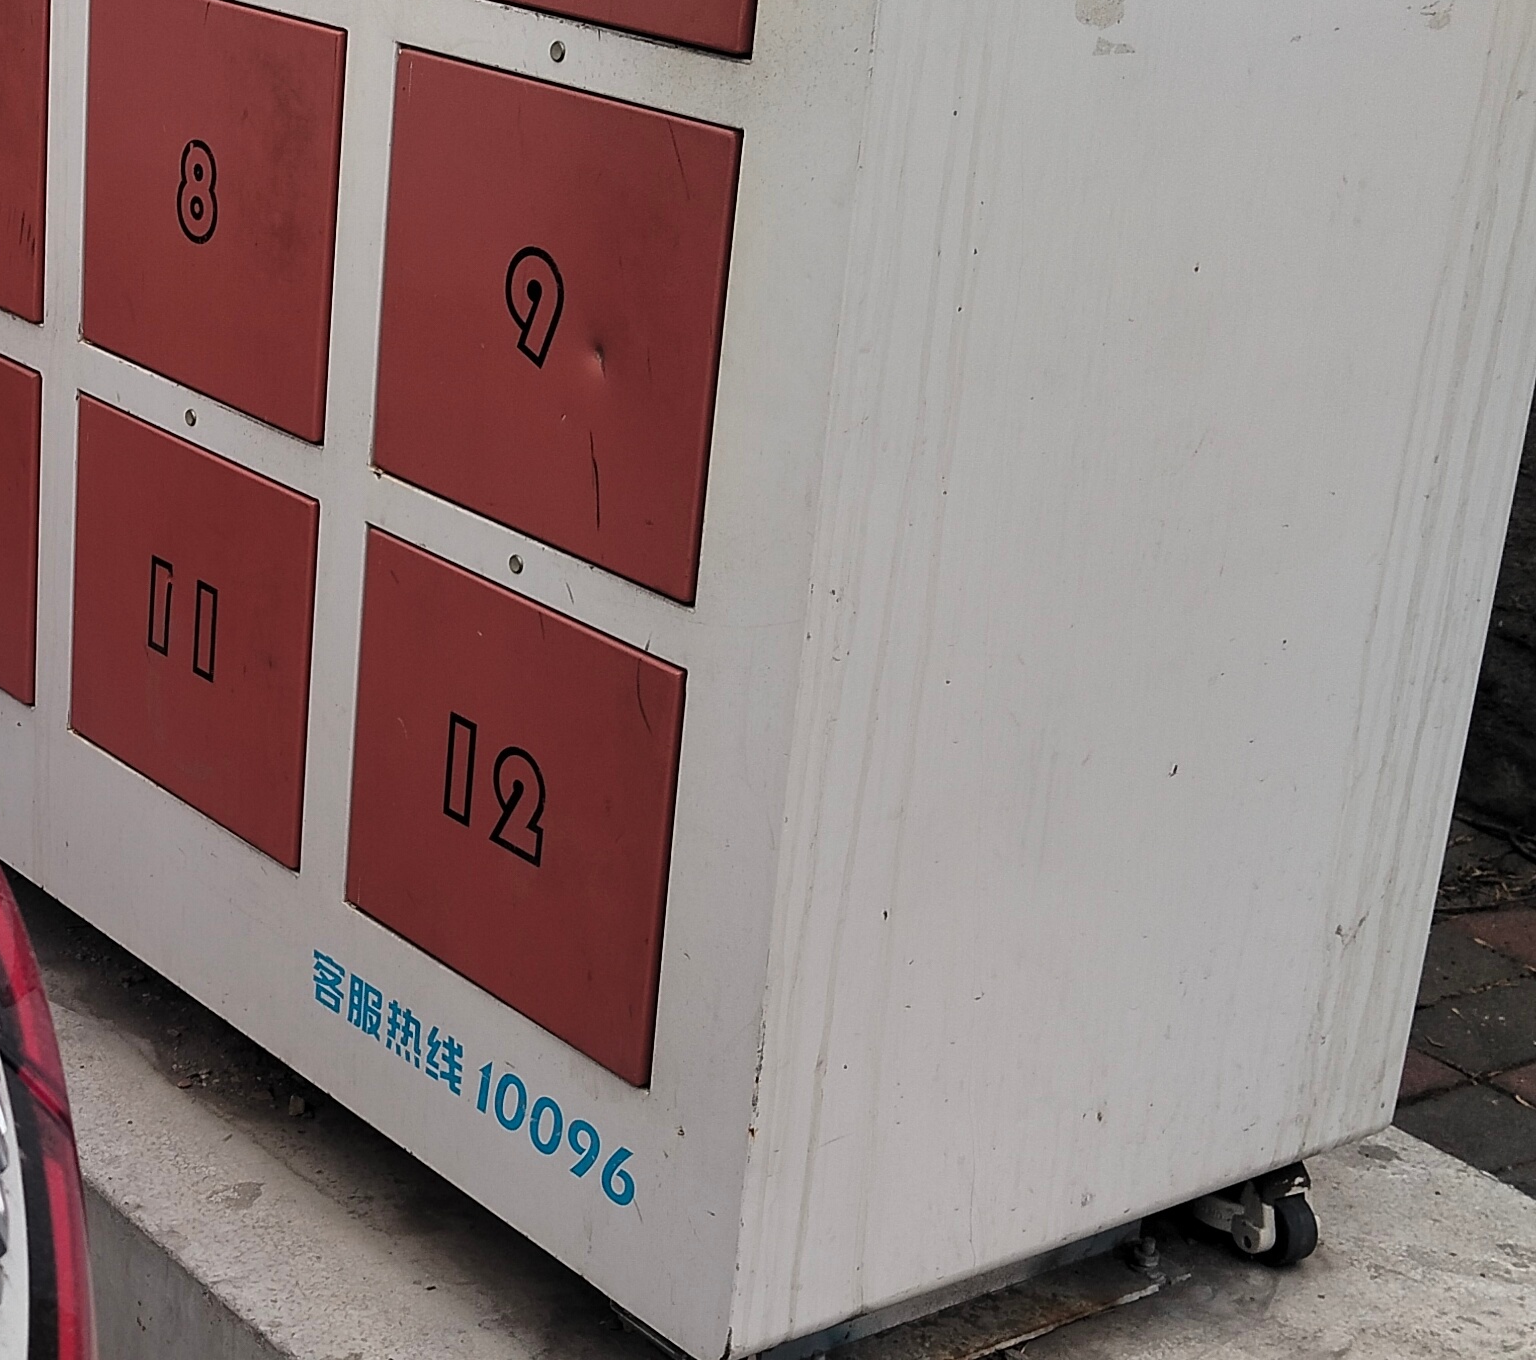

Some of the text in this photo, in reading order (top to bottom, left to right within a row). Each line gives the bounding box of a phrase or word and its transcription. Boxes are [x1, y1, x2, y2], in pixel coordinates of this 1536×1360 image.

[177, 139, 218, 244] 8
[505, 246, 564, 369] 9
[148, 555, 217, 682] 11
[444, 711, 546, 867] 12
